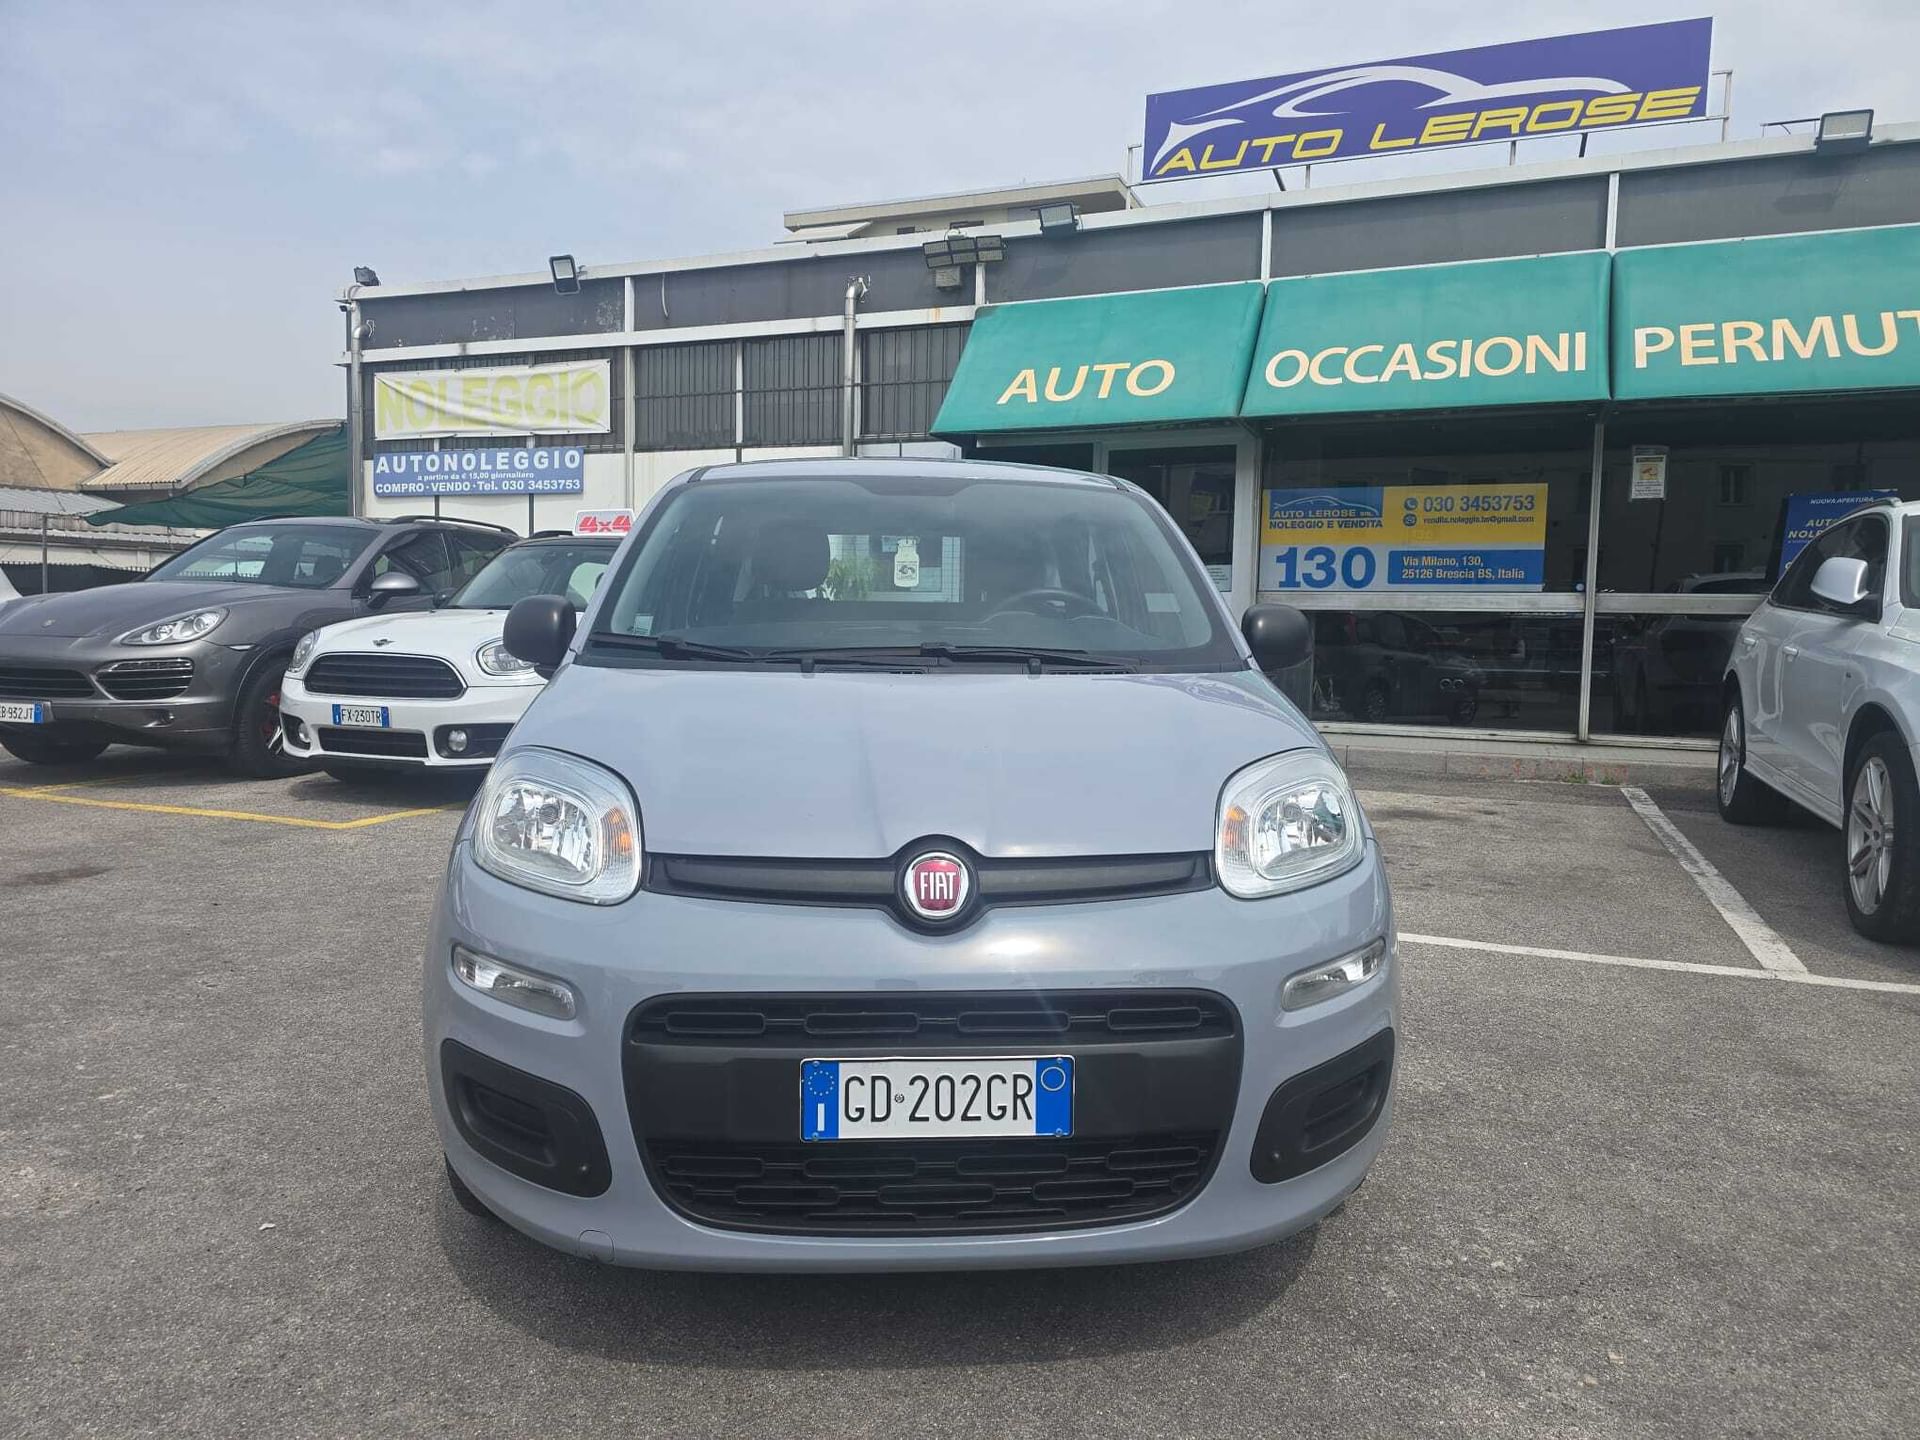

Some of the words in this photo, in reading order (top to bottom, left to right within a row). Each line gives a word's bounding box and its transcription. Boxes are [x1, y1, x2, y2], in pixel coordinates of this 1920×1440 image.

[1156, 128, 1344, 176] AUTO
[1369, 86, 1702, 150] LEROSE
[1264, 331, 1588, 390] OCCASIONI
[997, 359, 1176, 405] AUTO
[377, 370, 605, 431] NOLEGGIO
[376, 450, 580, 474] AUTONOLEGGIO
[376, 483, 425, 493] COMPRO
[431, 481, 471, 492] VENDO
[477, 480, 499, 491] Tel.
[502, 480, 525, 490] 030
[528, 479, 581, 490] 3453753
[424, 473, 449, 482] partire
[450, 472, 460, 480] da
[1423, 496, 1455, 512] 030
[1460, 495, 1535, 512] 3453753
[1273, 510, 1305, 518] AUTO
[1308, 509, 1356, 518] LEROSE
[579, 515, 631, 533] 4x4
[1269, 520, 1324, 530] NOLEGGIO
[1327, 520, 1334, 529] E
[1337, 519, 1383, 529] VENDITA
[1275, 546, 1377, 590] 130
[1402, 556, 1419, 566] Via
[1422, 555, 1459, 568] Milano,
[1463, 555, 1484, 568] 130,
[1402, 568, 1433, 579] 25126
[1436, 568, 1475, 579] Brescia
[1478, 568, 1495, 580] BS,
[1498, 567, 1525, 579] Italia
[919, 871, 956, 901] FIAT
